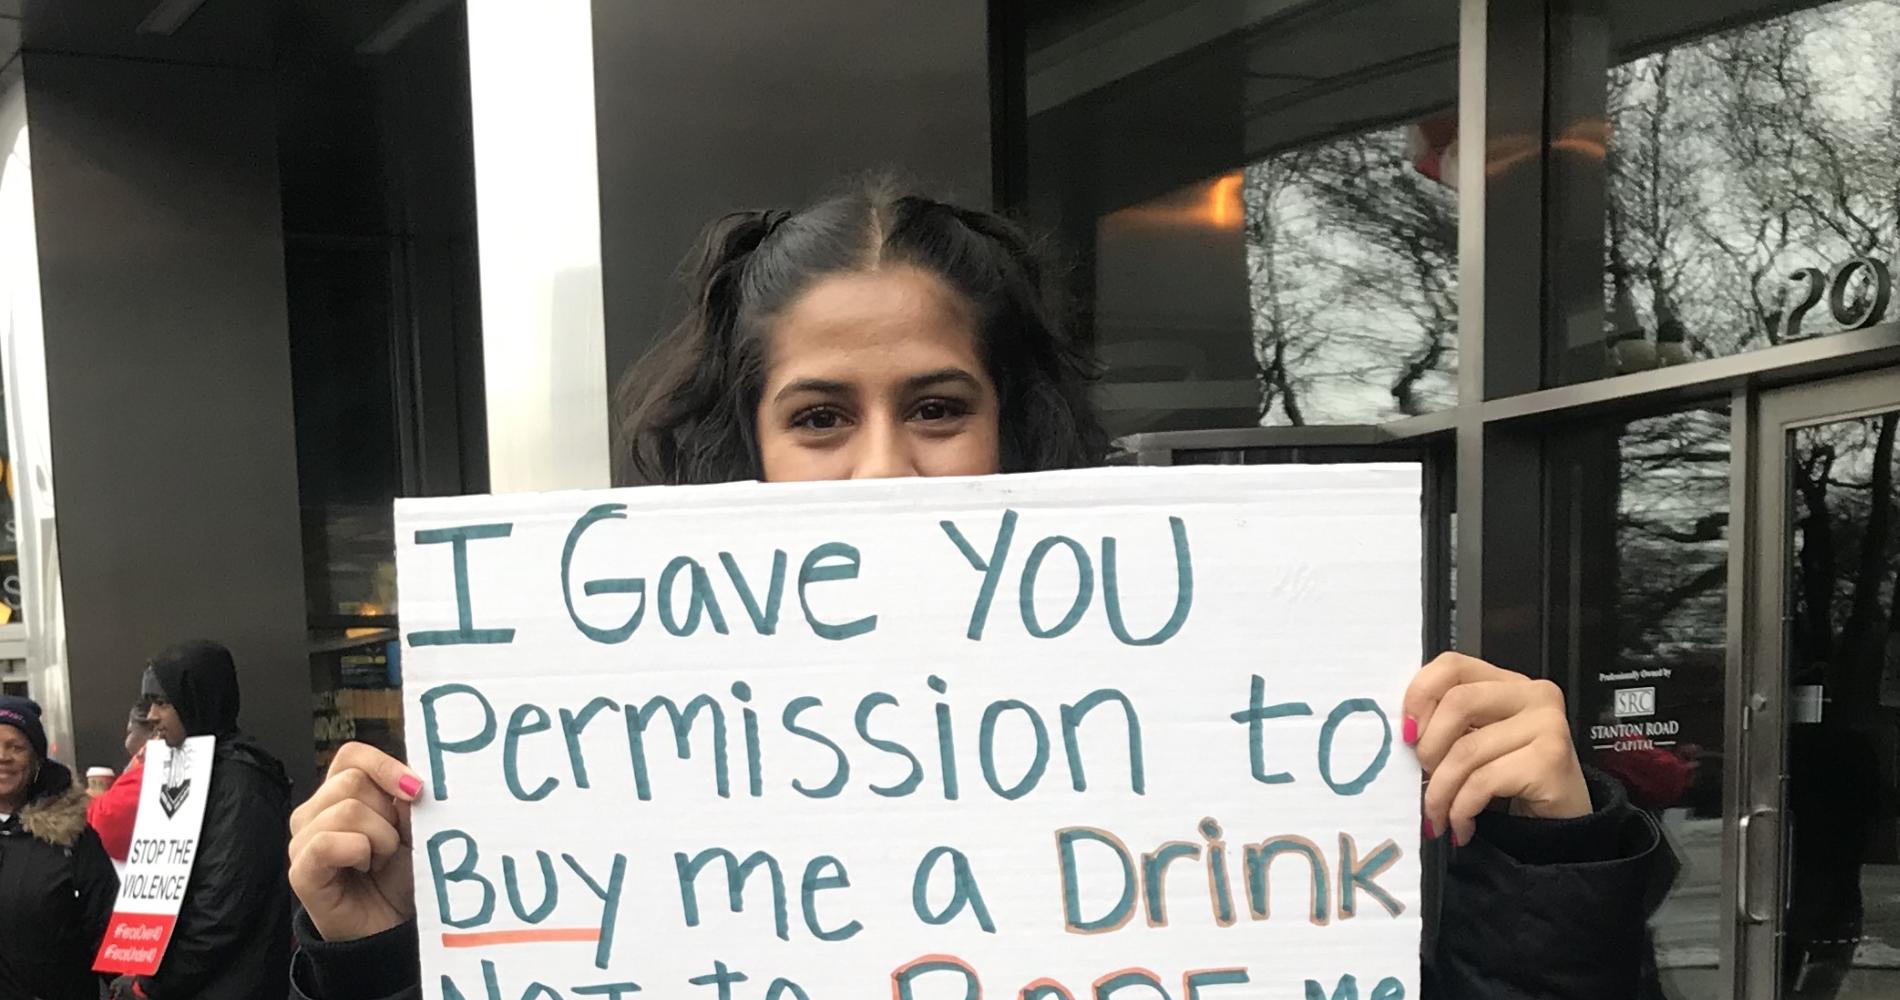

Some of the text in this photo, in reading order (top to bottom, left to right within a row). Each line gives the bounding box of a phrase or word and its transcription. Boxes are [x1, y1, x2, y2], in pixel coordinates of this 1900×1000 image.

[407, 503, 1193, 647] I Gave YOU
[1617, 689, 1654, 715] SRC
[420, 674, 1145, 801] Permission
[1231, 674, 1392, 796] to
[1590, 720, 1679, 740] STANTON ROAD
[1614, 739, 1655, 752] CAPITAL
[131, 839, 193, 864] STOP THE
[122, 874, 185, 900] VIOLENCE
[674, 847, 864, 942] me
[912, 846, 996, 934] a
[1055, 816, 1406, 935] Drink
